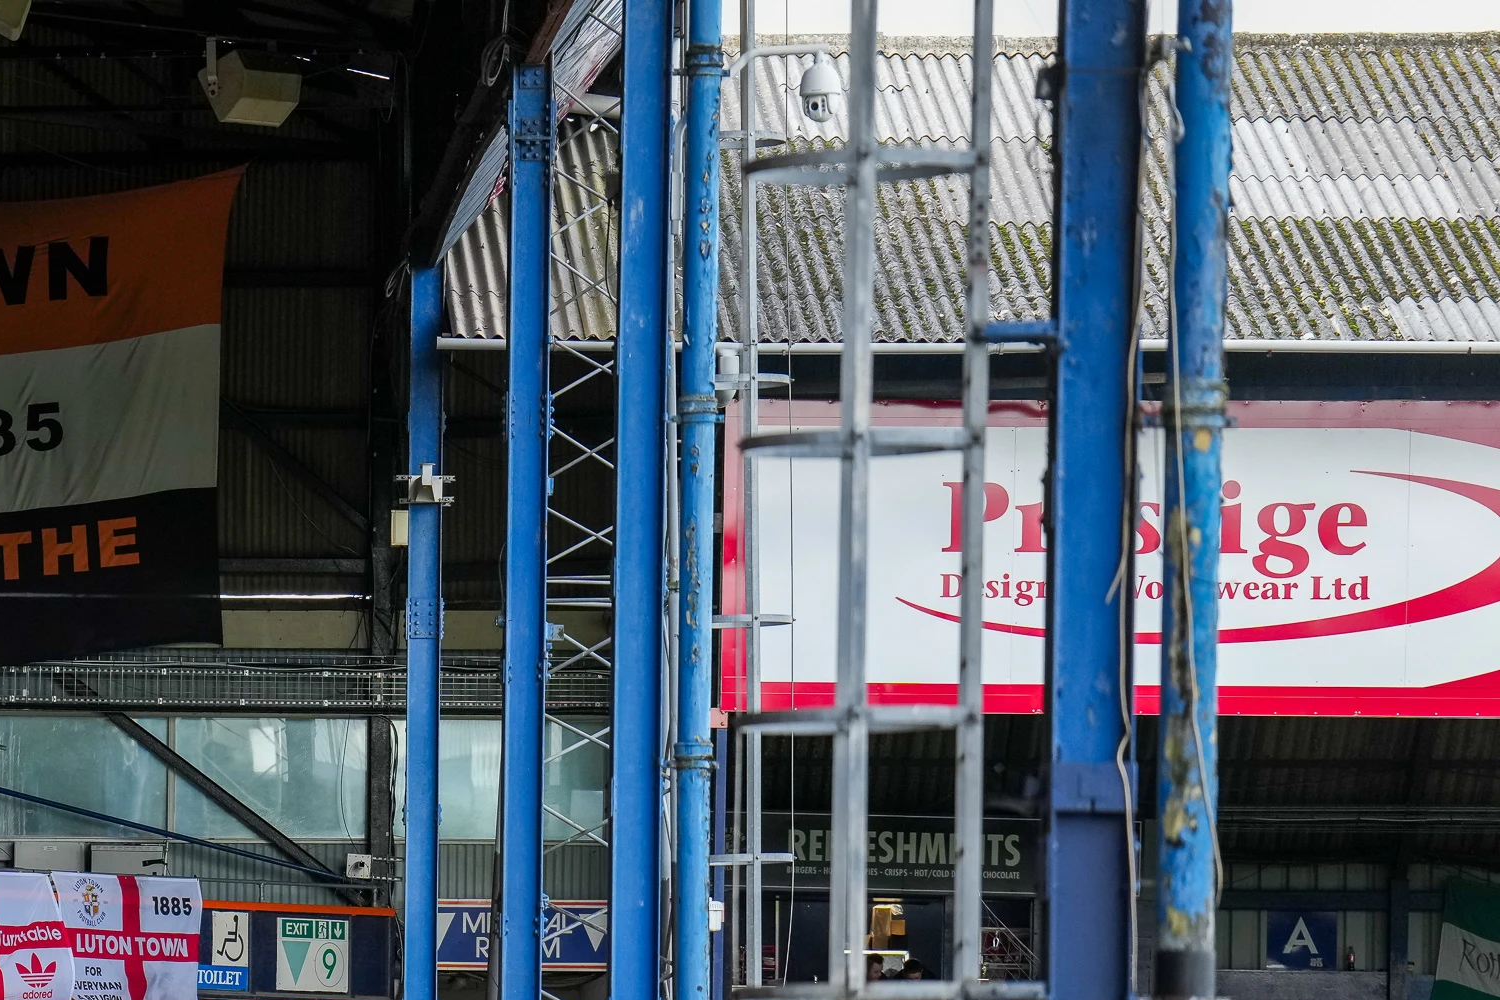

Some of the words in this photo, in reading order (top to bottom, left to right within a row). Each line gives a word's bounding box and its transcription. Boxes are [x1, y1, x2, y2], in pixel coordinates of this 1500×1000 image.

[942, 480, 1368, 578] Prsige
[1310, 576, 1371, 600] Ltd
[786, 866, 817, 875] BRGERS
[884, 869, 908, 877] CRISPS
[914, 869, 950, 878] HOT/COLD
[982, 871, 1020, 879] CHOCOLATE
[152, 896, 193, 916] 1885
[285, 922, 309, 935] EXIT
[1282, 916, 1319, 954] A
[76, 933, 133, 955] LUTON
[135, 937, 189, 957] TOWN
[85, 966, 102, 976] FOR
[322, 948, 338, 980] 9
[197, 969, 242, 985] TOILET
[22, 989, 53, 1000] adored
